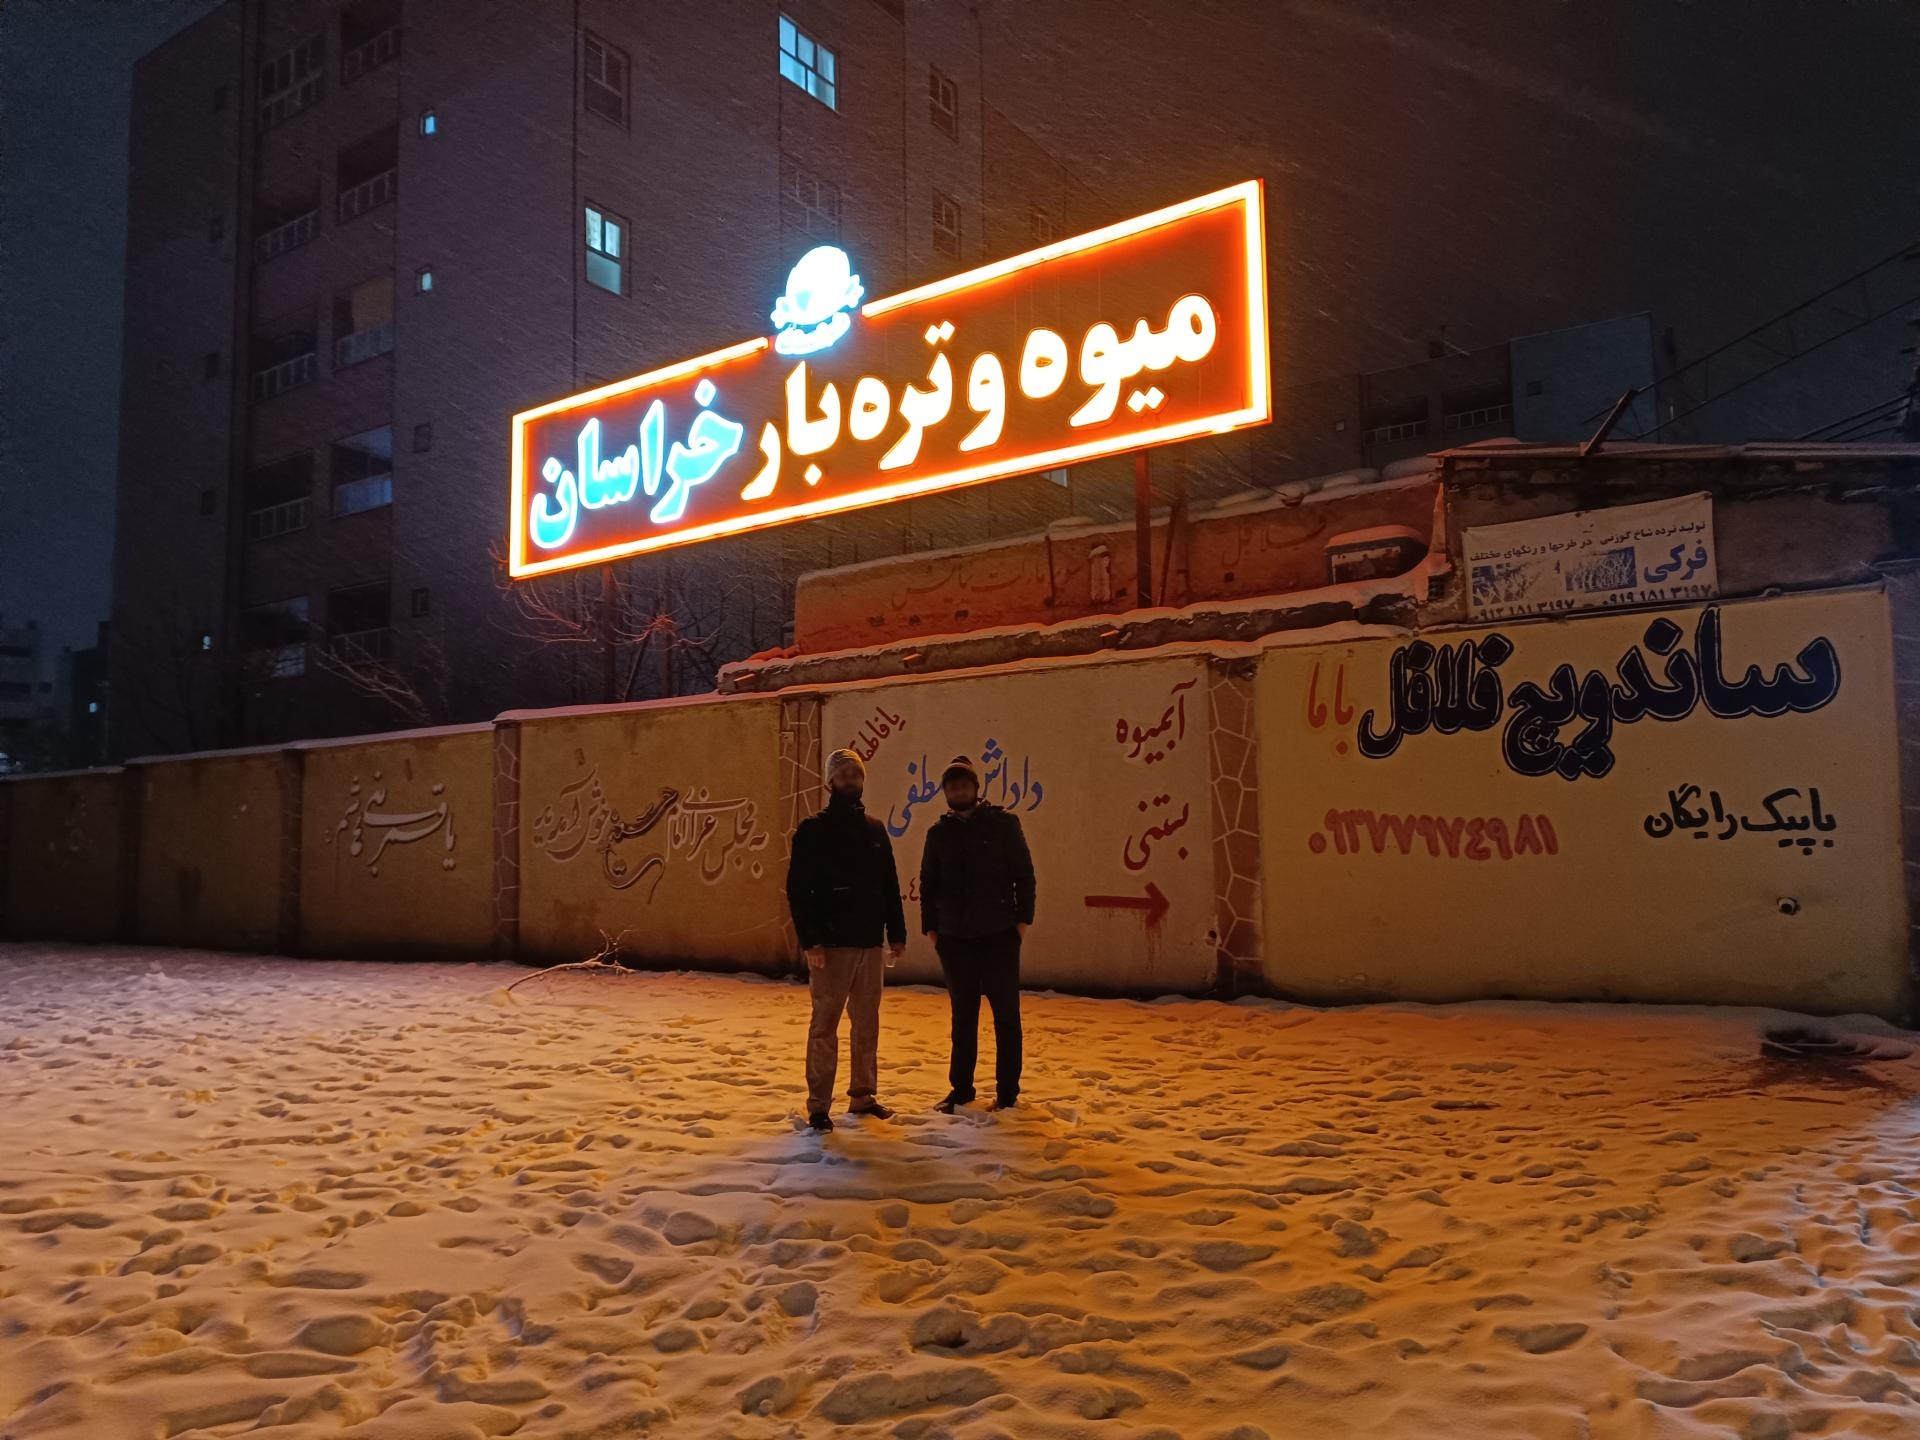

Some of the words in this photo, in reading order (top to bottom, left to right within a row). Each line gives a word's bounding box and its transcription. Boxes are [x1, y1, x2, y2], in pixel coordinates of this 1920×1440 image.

[1020, 293, 1218, 428] میوه
[960, 352, 1007, 452] و
[530, 379, 745, 549] خراسان
[1469, 551, 1501, 562] مختلف
[1503, 545, 1539, 559] رنگهای
[1548, 540, 1577, 553] طرحها
[1579, 538, 1593, 549] در
[1633, 528, 1653, 541] شاخ
[1643, 540, 1709, 584] فرکی
[1654, 525, 1677, 537] نرده
[1679, 521, 1707, 534] تولید
[1115, 677, 1198, 765] آبمیوه
[1358, 634, 1515, 760] فلافل
[1503, 605, 1842, 780] ساندویچ
[336, 775, 363, 870] هاشم
[366, 782, 450, 867] قمر
[441, 812, 457, 872] یا
[532, 762, 600, 849] آمدید
[545, 778, 612, 863] خوش
[1124, 793, 1190, 871] بستنی
[1643, 783, 1739, 841] رایگان
